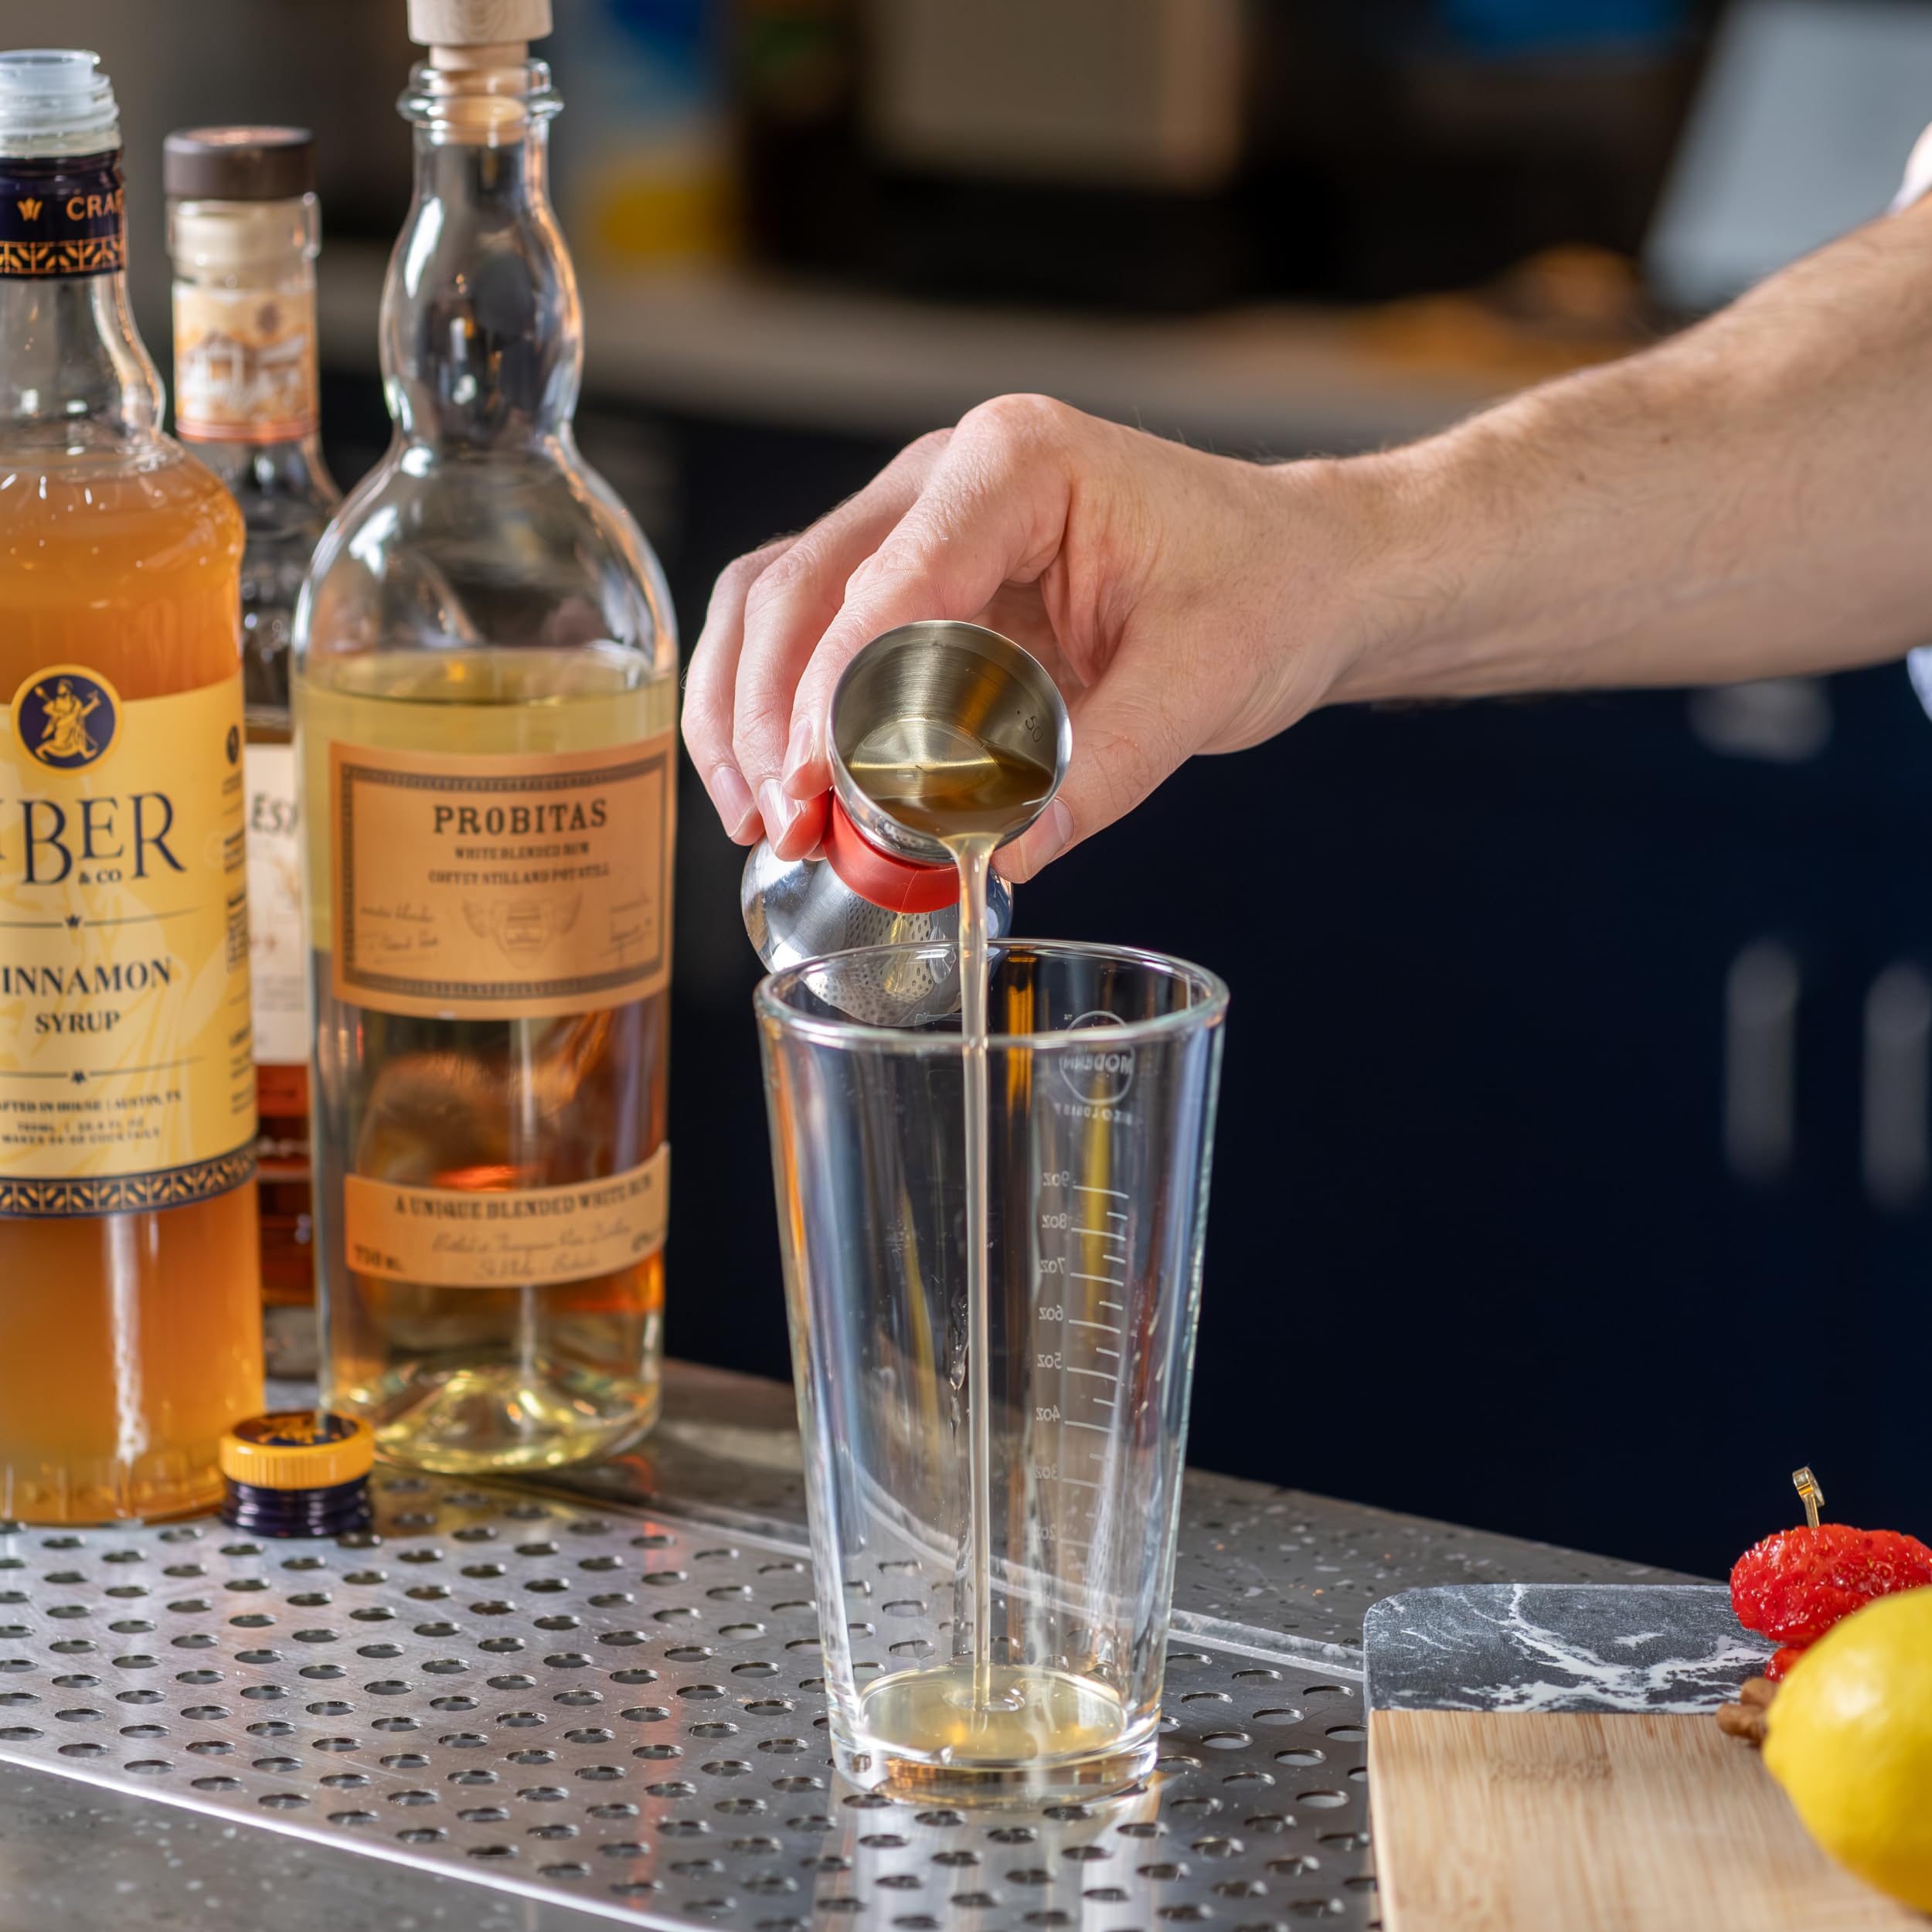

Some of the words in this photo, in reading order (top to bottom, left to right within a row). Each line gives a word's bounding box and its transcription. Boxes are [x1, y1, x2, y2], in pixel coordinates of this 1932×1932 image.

[434, 798, 607, 835] PROBITAS
[0, 791, 186, 886] BER
[455, 845, 497, 861] WHITE
[501, 843, 560, 860] BLENDED
[79, 871, 90, 885] &
[96, 869, 122, 883] CO
[35, 1012, 121, 1034] SYRUP
[394, 1193, 405, 1215] A
[409, 1196, 481, 1219] UNIQUE
[485, 1195, 577, 1220] BLENDED
